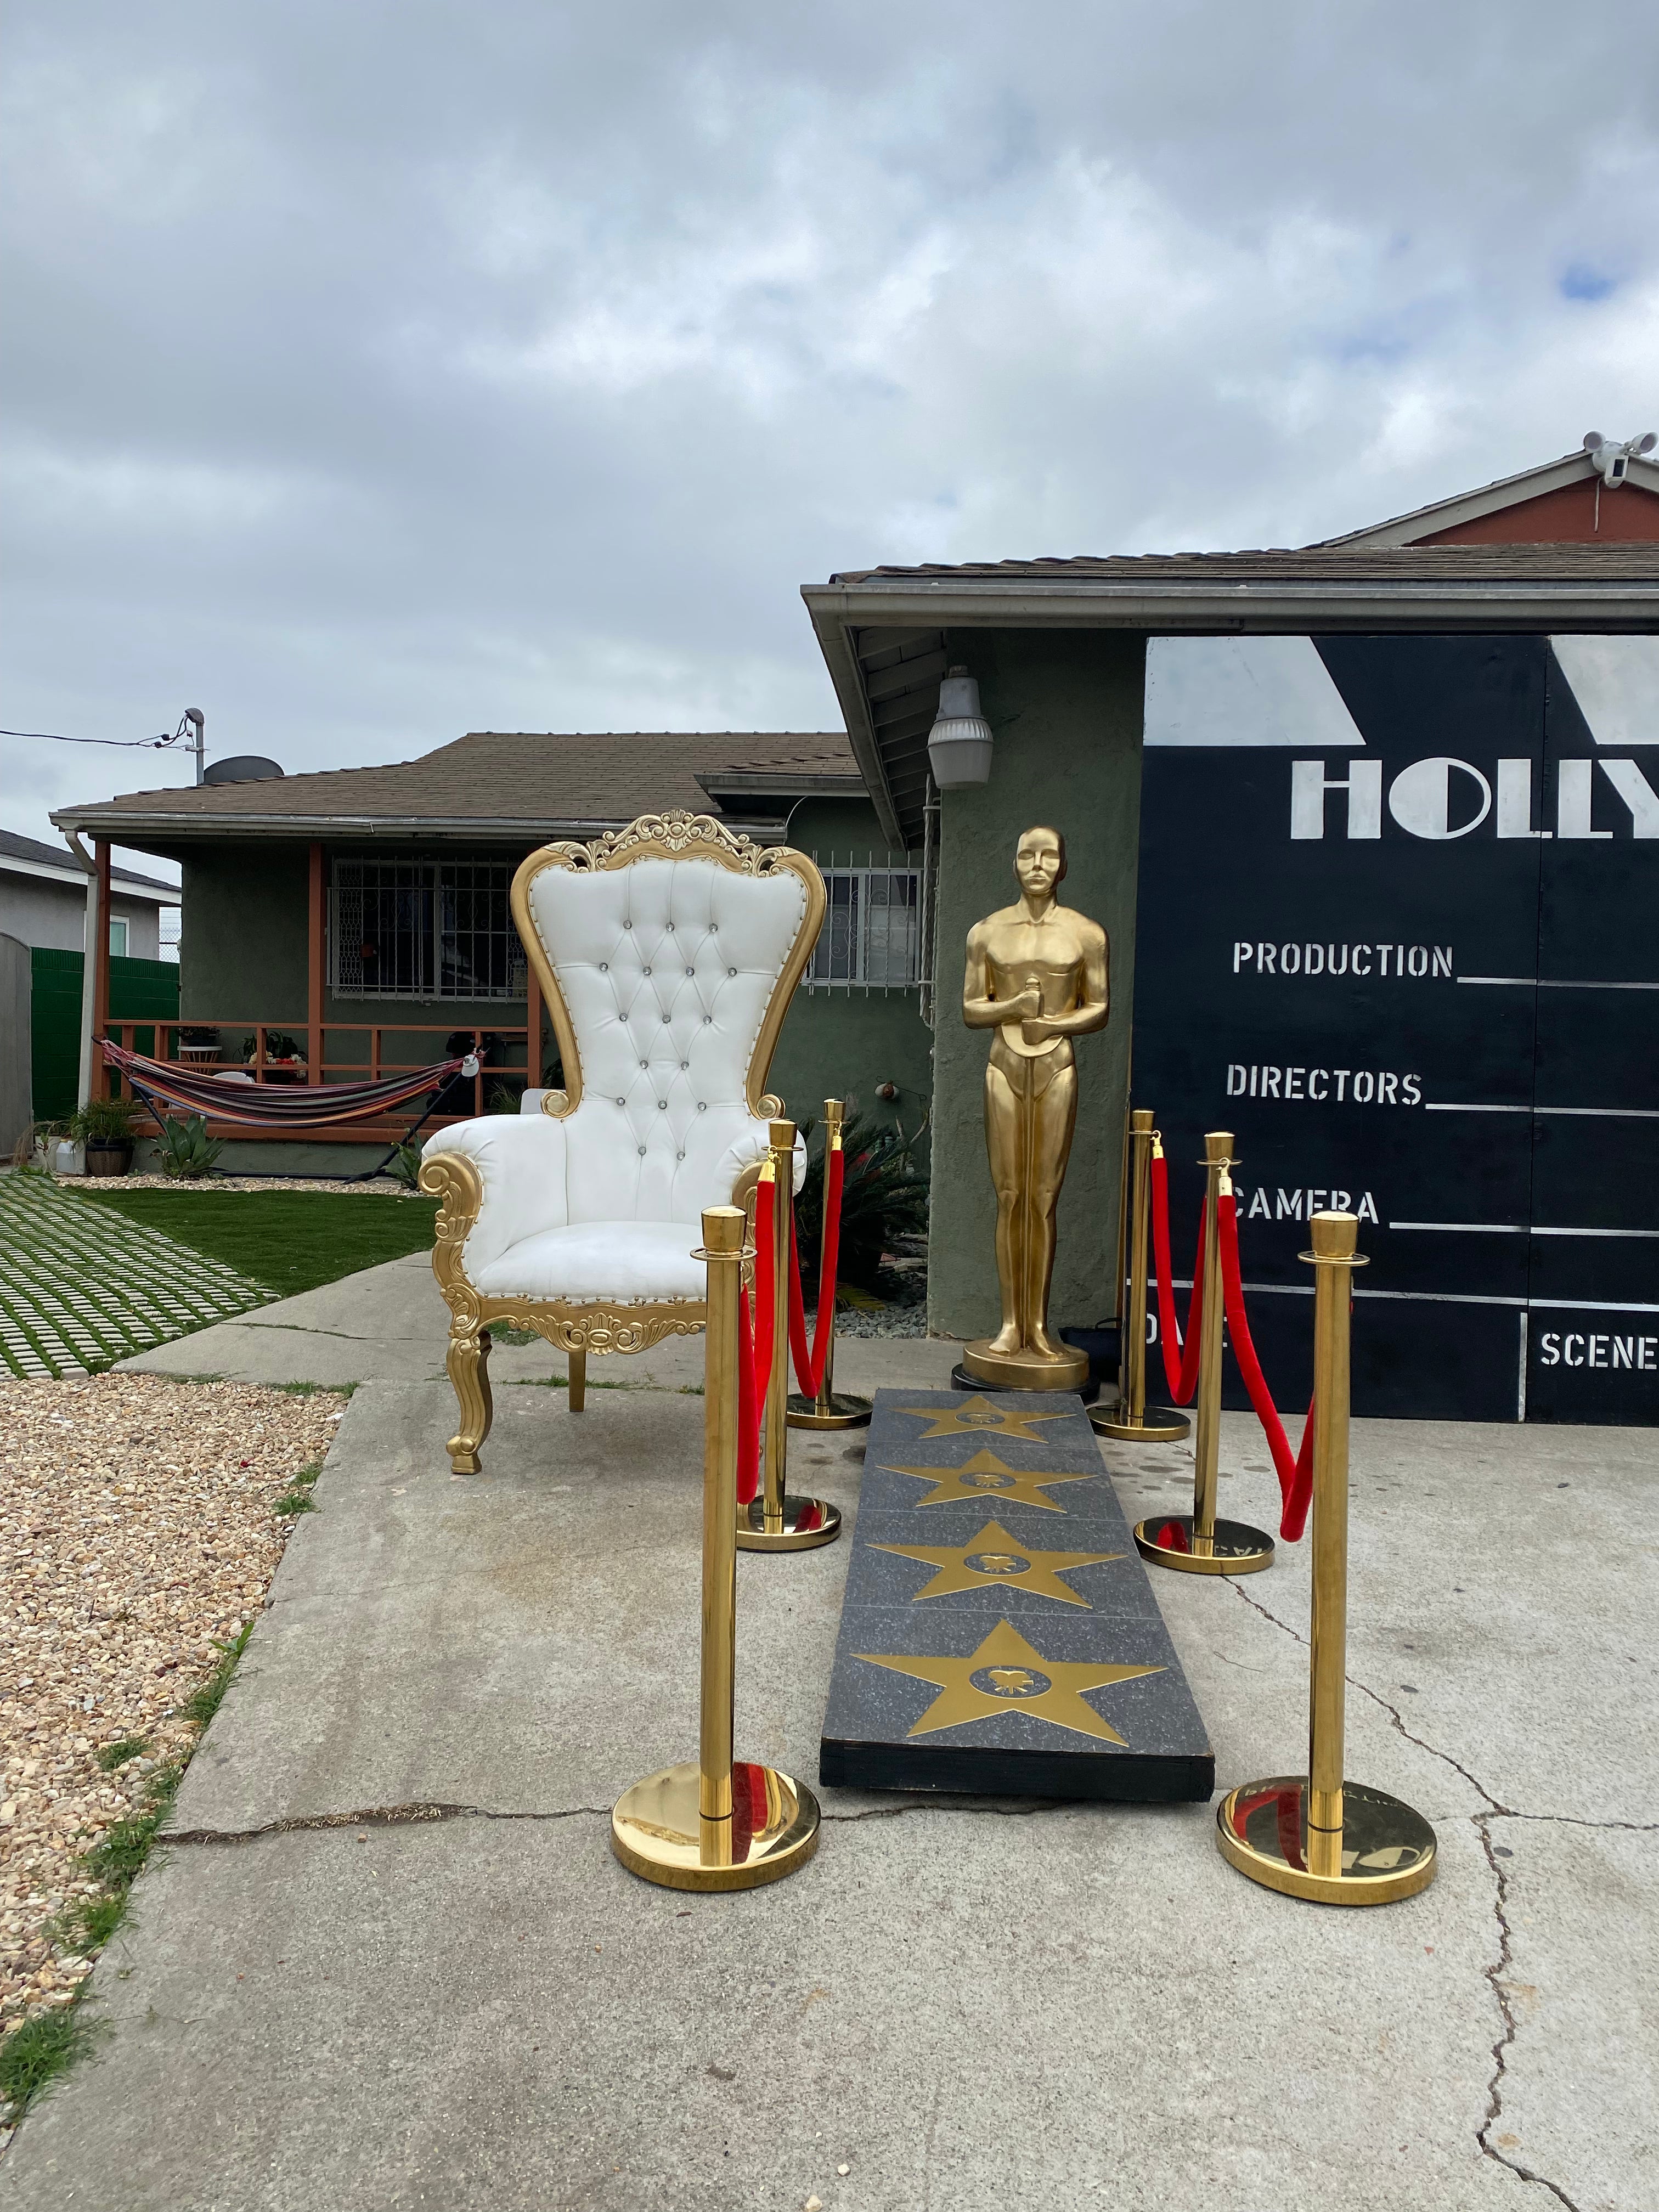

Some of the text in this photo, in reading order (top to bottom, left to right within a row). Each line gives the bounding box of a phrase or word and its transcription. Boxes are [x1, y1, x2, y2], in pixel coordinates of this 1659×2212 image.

[1291, 758, 1659, 839] HOLLY
[1234, 943, 1453, 977] PRODUCTION
[1227, 1064, 1422, 1105] DIRECTORS
[1541, 1333, 1658, 1370] SCENE
